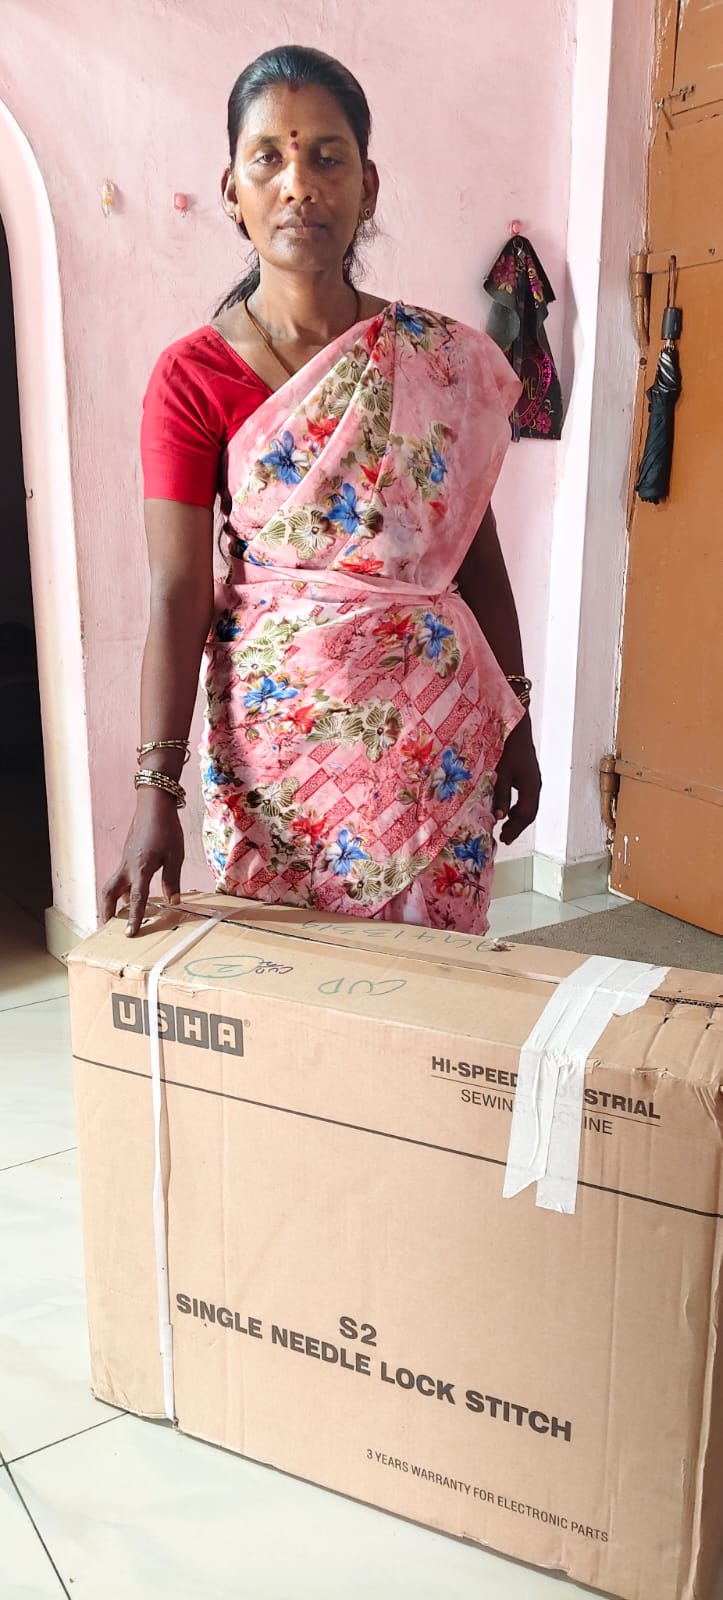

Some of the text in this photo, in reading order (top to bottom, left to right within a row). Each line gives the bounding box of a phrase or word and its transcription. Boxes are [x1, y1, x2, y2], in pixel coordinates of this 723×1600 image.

[115, 996, 240, 1053] USHA
[460, 1088, 513, 1113] SEWIN
[338, 1315, 378, 1348] S2
[175, 1293, 572, 1443] SINGLE NEEDLE LOCK STITCH
[366, 1448, 609, 1543] 3 YEARS WARRANTY FOR ELECTRONIC PARTS
